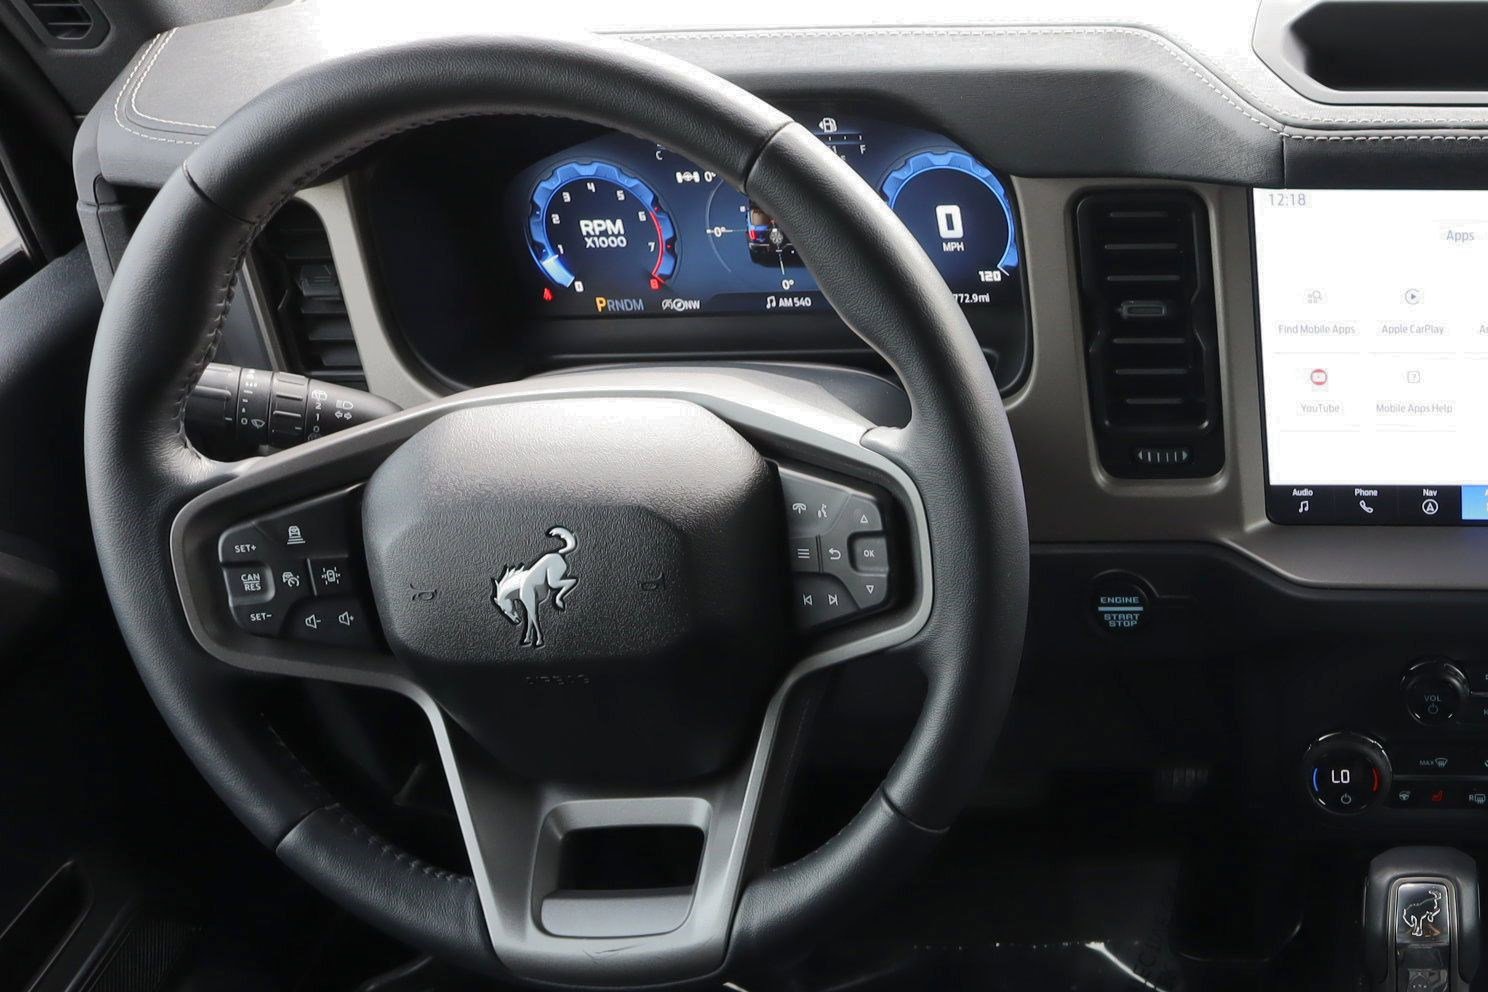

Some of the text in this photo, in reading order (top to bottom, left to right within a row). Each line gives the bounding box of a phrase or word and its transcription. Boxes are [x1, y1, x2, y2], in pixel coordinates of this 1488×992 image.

[860, 144, 866, 155] F
[655, 151, 663, 160] C
[587, 182, 596, 193] 4
[562, 192, 571, 202] 3
[617, 190, 625, 201] 5
[1268, 193, 1306, 206] 12:18
[551, 214, 560, 224] 2
[638, 211, 646, 222] 6
[935, 205, 964, 239] 0
[579, 219, 625, 236] RPM
[1446, 229, 1475, 242] Apps
[584, 236, 627, 249] X1000
[648, 242, 655, 252] 7
[942, 242, 964, 252] MPH
[558, 244, 564, 254] 1
[978, 271, 1001, 282] 120
[574, 281, 584, 292] 0
[685, 300, 700, 310] NW
[778, 296, 812, 308] AM 540
[1278, 324, 1355, 336] Find Mobile Apps
[1381, 324, 1444, 336] Apple CarPlay
[315, 402, 321, 410] 2
[1300, 403, 1340, 413] YouTube
[1376, 403, 1453, 414] Mobile Apps Help
[1292, 488, 1313, 497] Audio
[1354, 488, 1378, 497] Phone
[1422, 489, 1438, 497] Nav
[234, 544, 256, 553] SET+
[863, 549, 875, 558] OK
[241, 573, 261, 582] CAN
[244, 583, 261, 592] RES
[1100, 596, 1139, 604] ENGINE
[250, 613, 272, 622] SET-
[1104, 613, 1140, 621] START
[1332, 769, 1350, 784] LO
